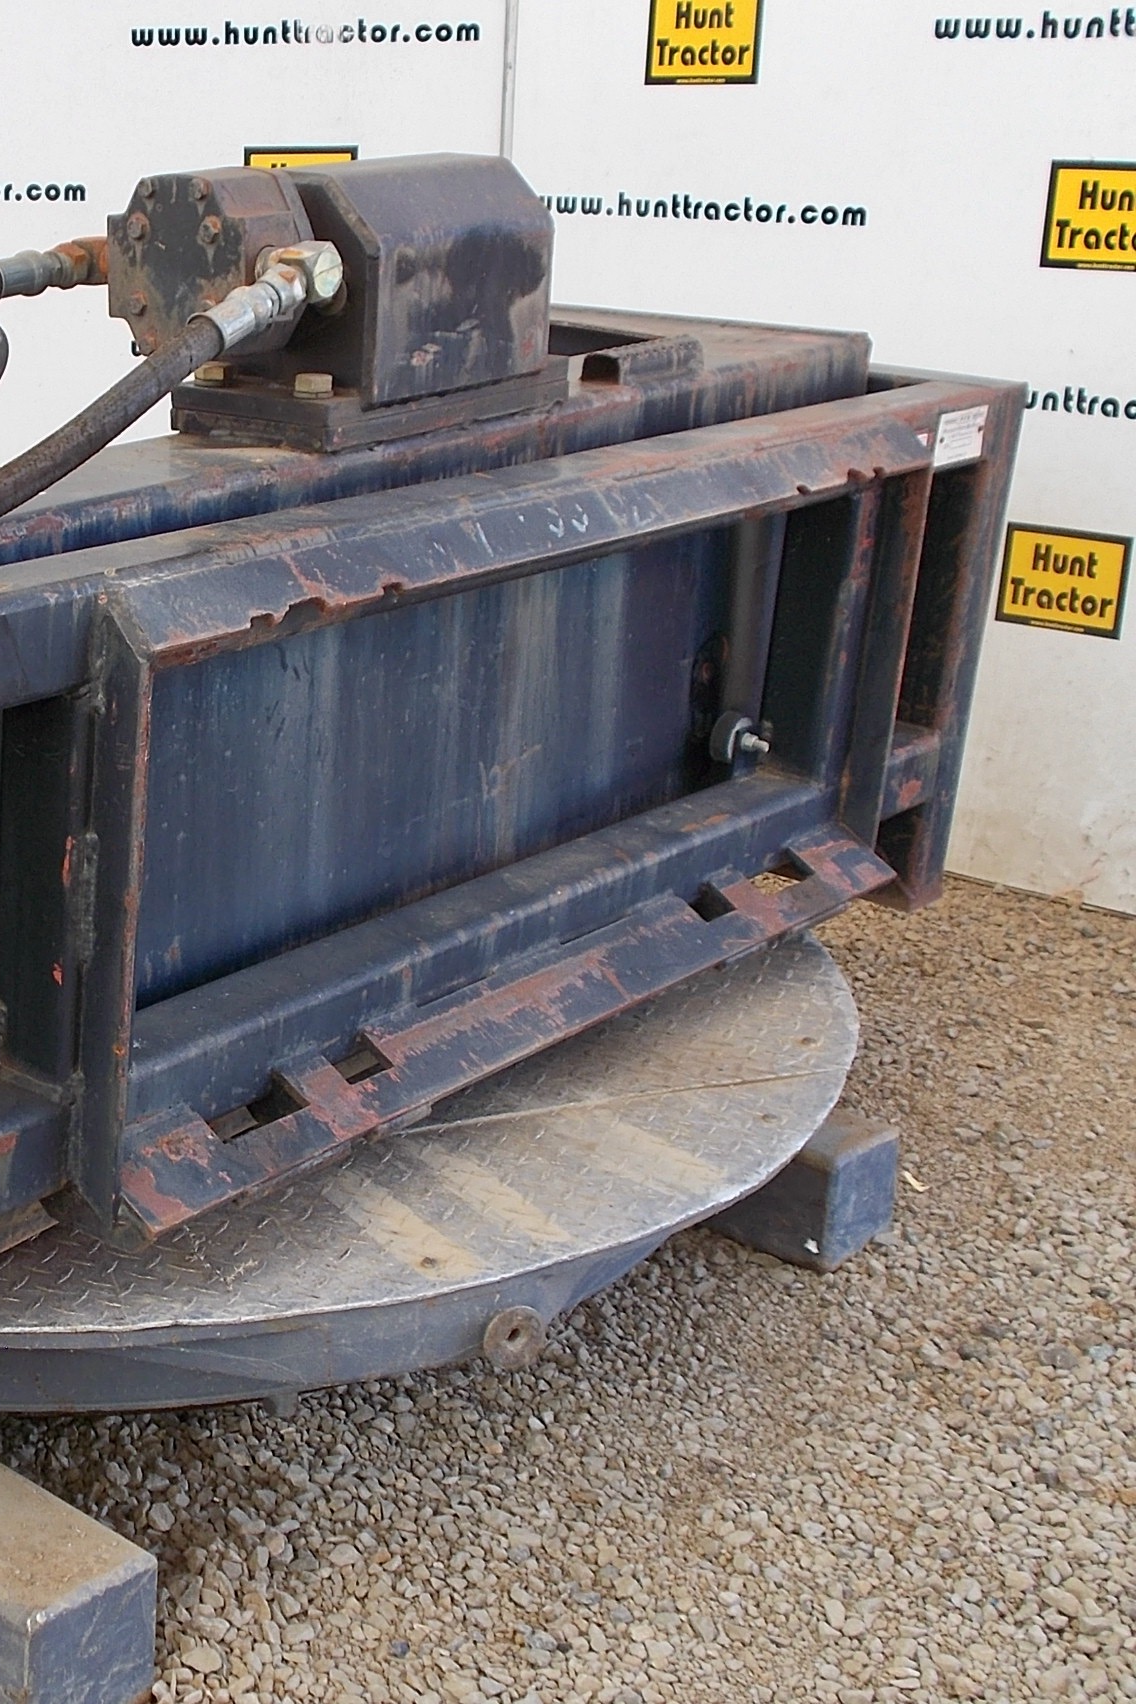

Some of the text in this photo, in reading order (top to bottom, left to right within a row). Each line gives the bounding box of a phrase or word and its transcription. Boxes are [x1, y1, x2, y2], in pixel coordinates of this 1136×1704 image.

[674, 1, 734, 30] Hunt
[131, 18, 480, 47] www.hunttractor.com
[656, 39, 751, 67] Tractor
[1055, 219, 1136, 252] Tract
[1031, 542, 1098, 579] Hunt
[1011, 577, 1114, 618] Tractor
